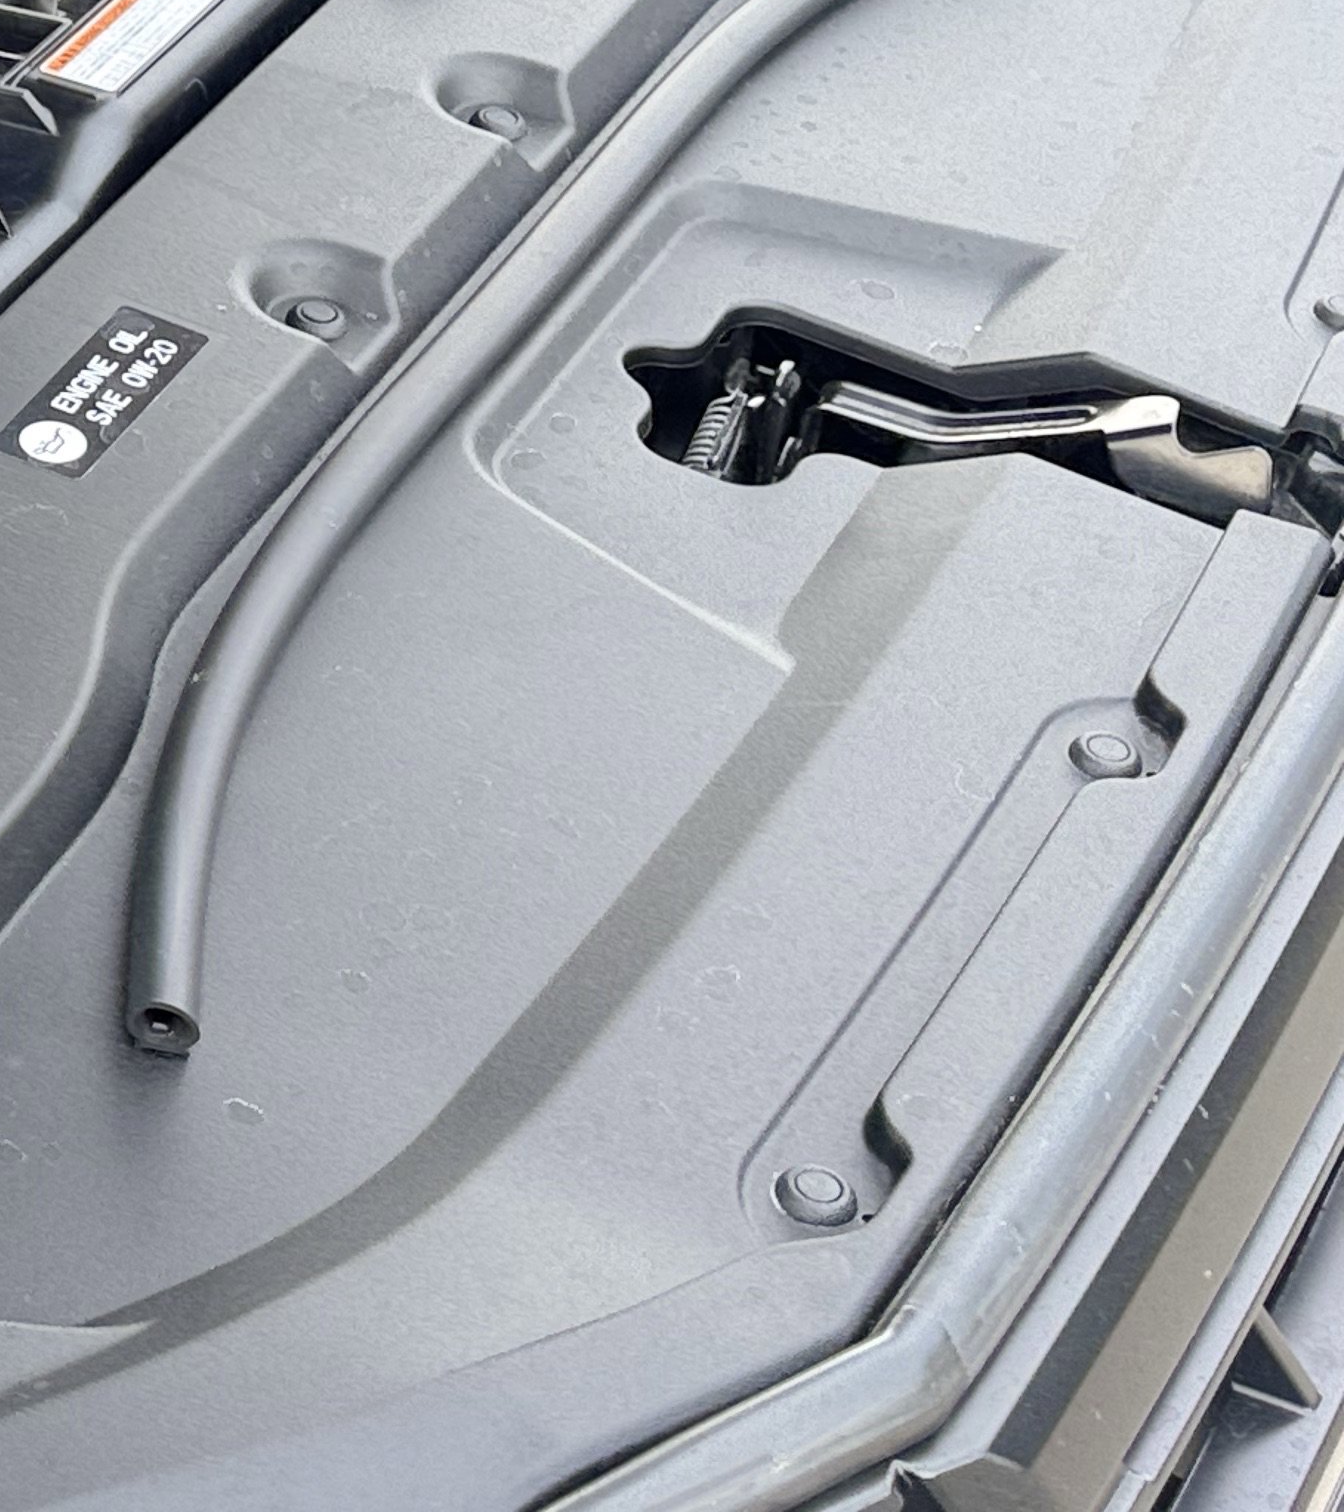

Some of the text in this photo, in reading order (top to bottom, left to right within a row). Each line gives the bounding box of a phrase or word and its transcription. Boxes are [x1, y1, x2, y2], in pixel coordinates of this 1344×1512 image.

[49, 354, 120, 415] ENGINE
[85, 339, 179, 426] SAE 0W-20
